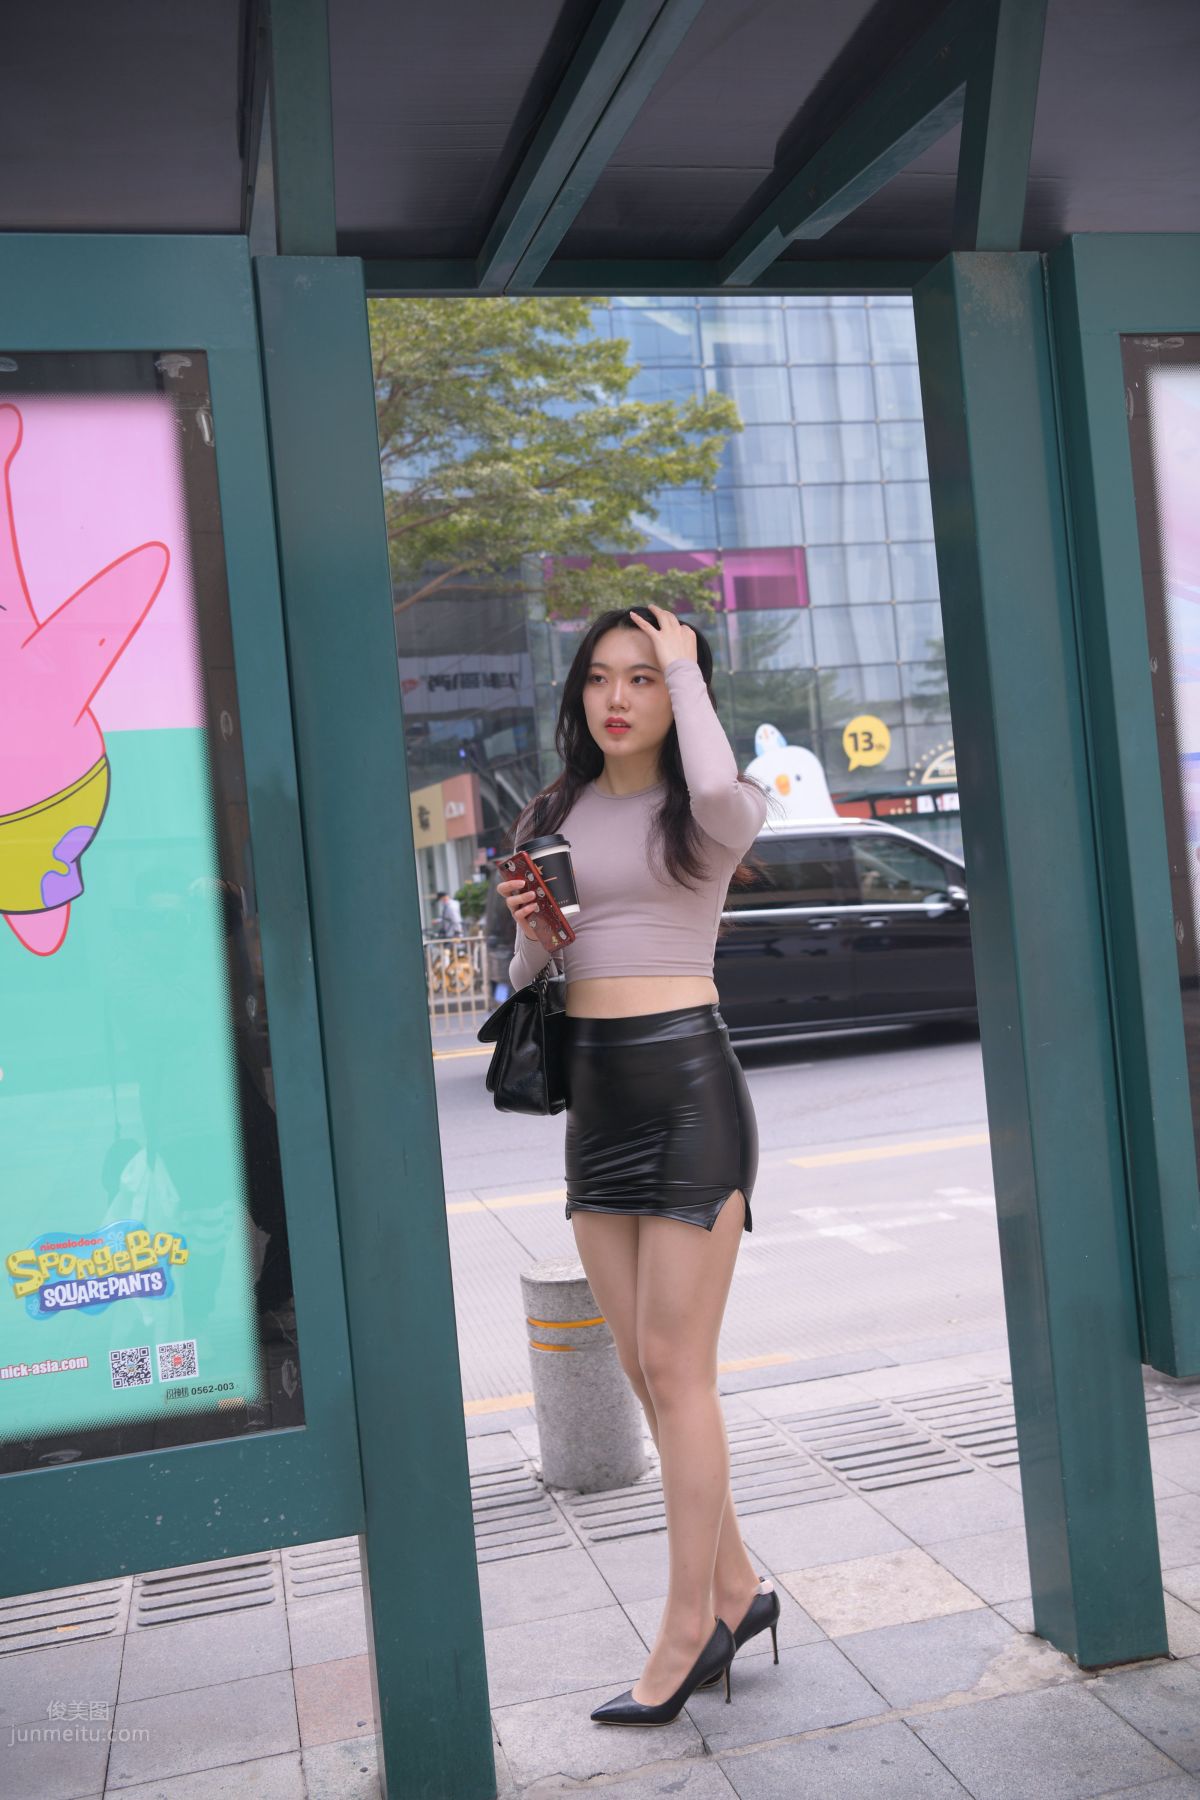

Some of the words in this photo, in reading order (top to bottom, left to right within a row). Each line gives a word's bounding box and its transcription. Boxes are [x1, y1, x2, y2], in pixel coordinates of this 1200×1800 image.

[40, 1237, 104, 1251] nickelodeon
[43, 1272, 163, 1307] SQUAREPANTS
[0, 1356, 88, 1379] nick-asia.com
[191, 1382, 235, 1396] 0562-003
